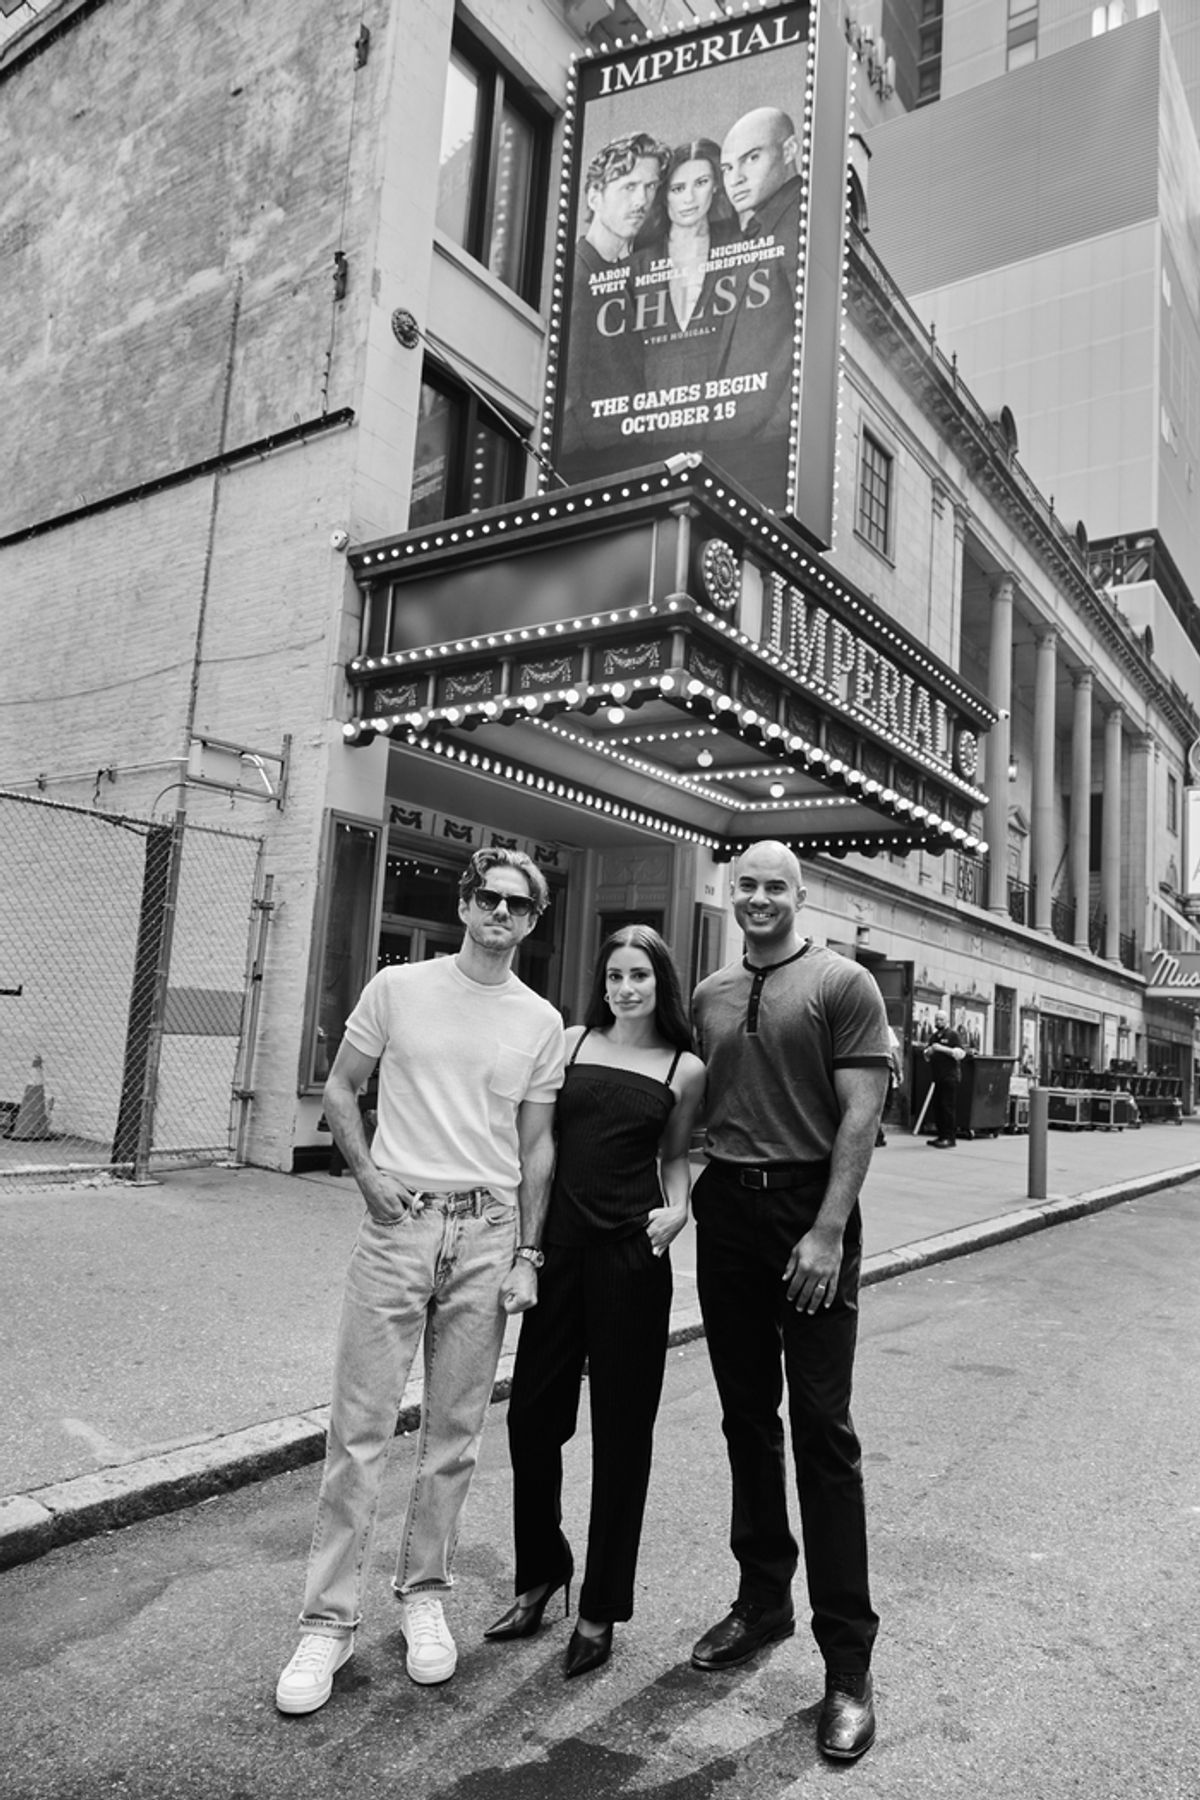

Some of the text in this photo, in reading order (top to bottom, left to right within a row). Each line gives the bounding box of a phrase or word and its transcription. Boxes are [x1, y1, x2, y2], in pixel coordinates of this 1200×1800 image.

[599, 16, 801, 95] IMPERIAL
[698, 245, 785, 273] CHRISTOPHER
[710, 235, 775, 259] NICHOLAS
[588, 266, 631, 285] AARON
[635, 266, 688, 287] MICHELE
[650, 257, 675, 272] LEA
[591, 279, 627, 296] TVEIT
[596, 268, 771, 337] CHSS
[651, 326, 711, 345] THE MUSICAL
[591, 372, 769, 418] THE GAMES BEGIN
[621, 401, 736, 435] OCTOBER 15
[766, 570, 953, 770] IMPERIAL
